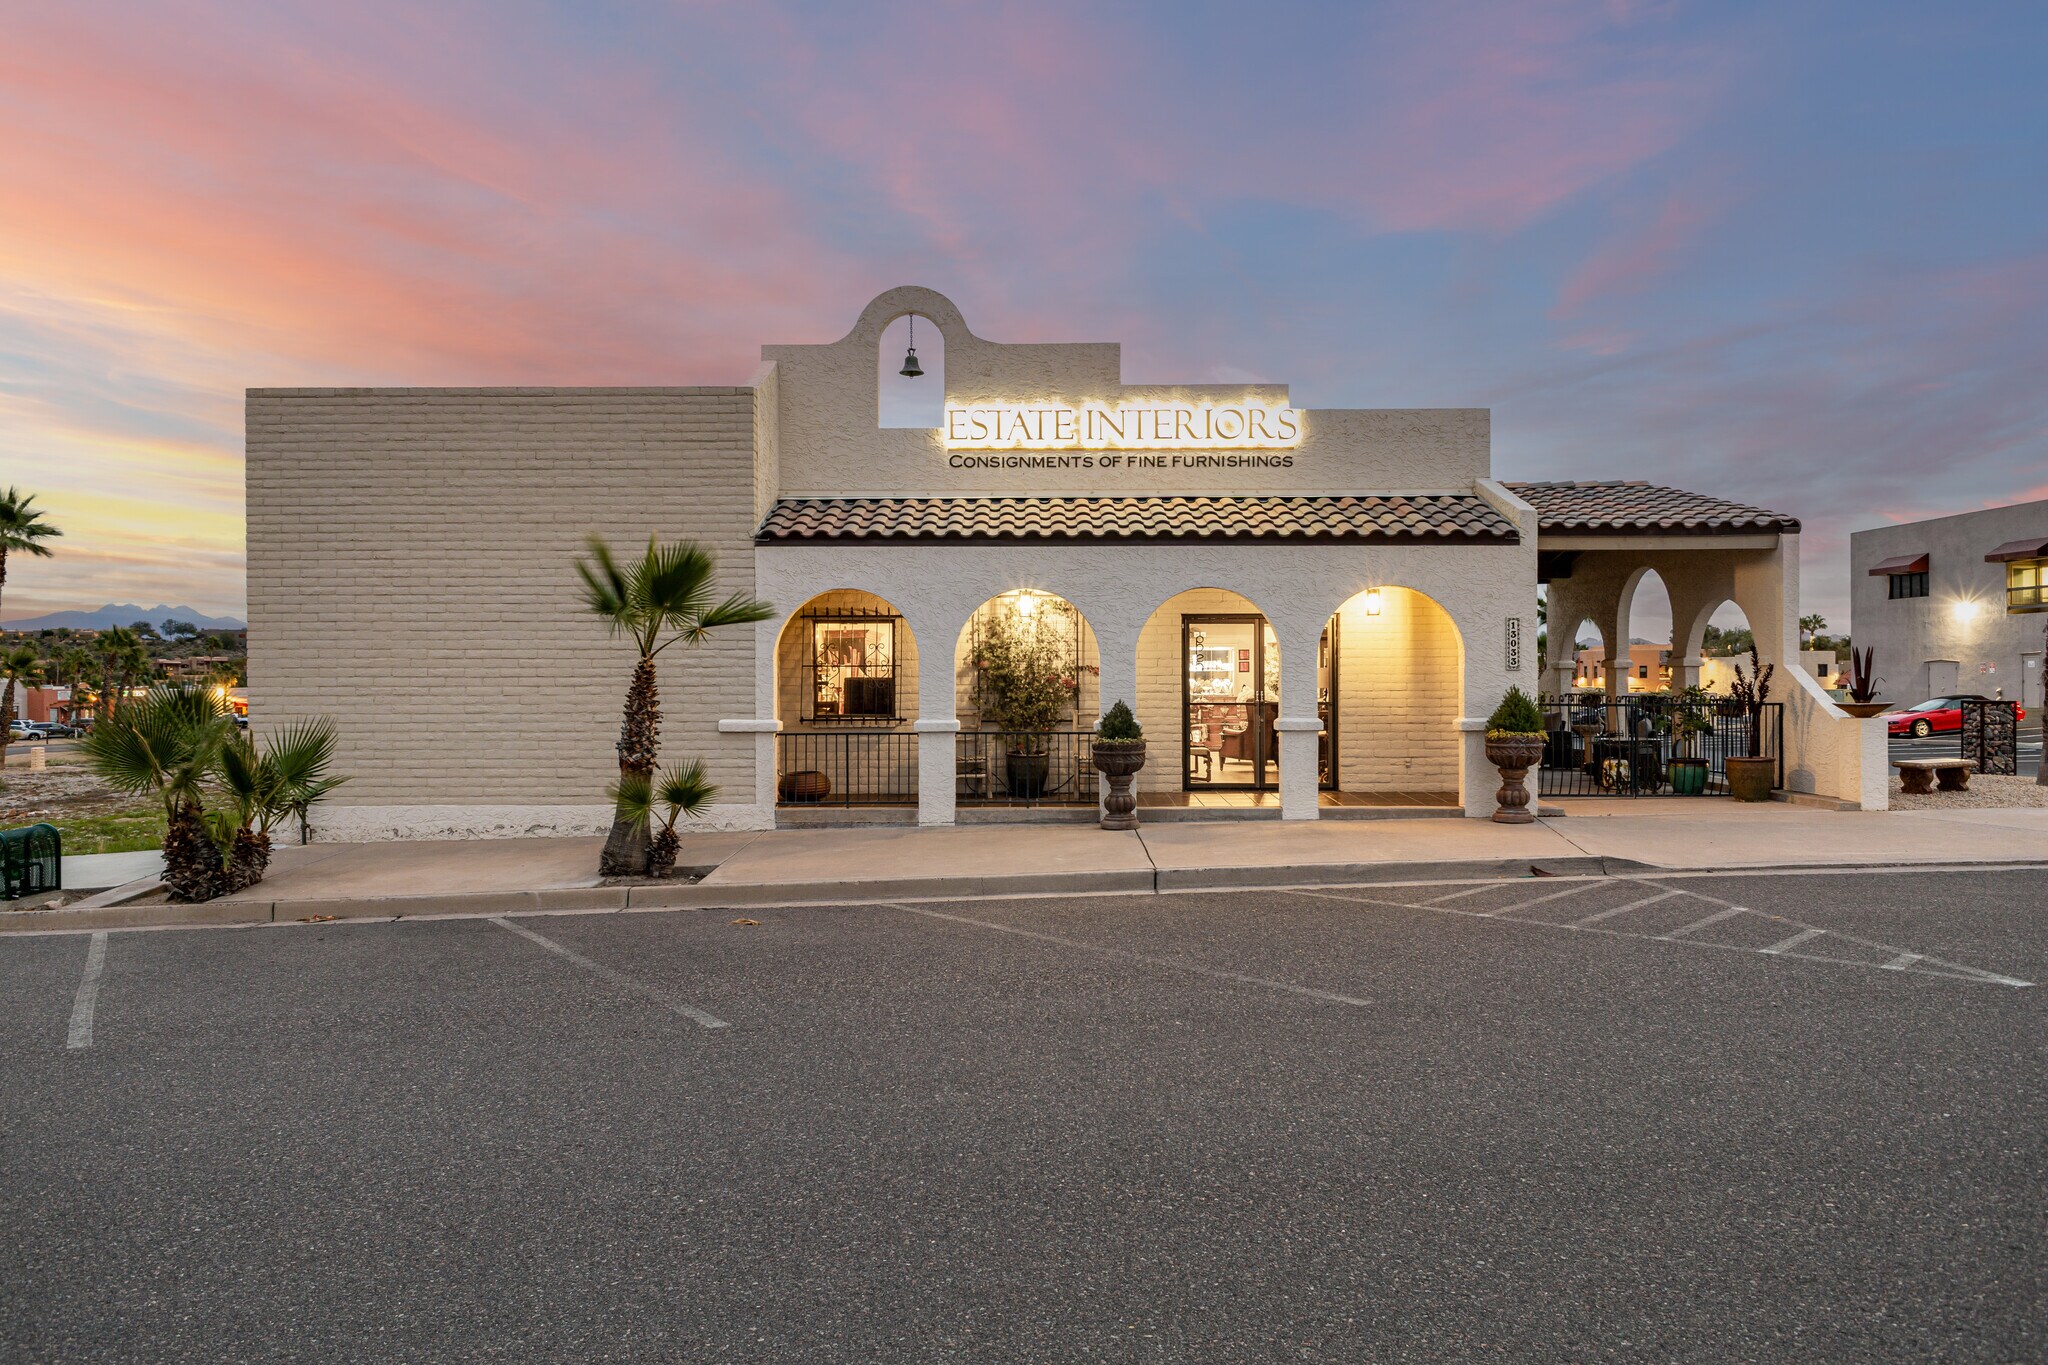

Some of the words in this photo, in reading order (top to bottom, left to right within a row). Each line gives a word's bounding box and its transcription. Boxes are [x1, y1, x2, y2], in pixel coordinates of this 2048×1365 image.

[948, 409, 1074, 441] ESTATE
[1086, 408, 1297, 440] INTERIORS
[949, 454, 1094, 468] CONSIGNMENTS
[1099, 455, 1123, 468] OF
[1127, 455, 1167, 468] FINE
[1172, 455, 1294, 467] FURNISHINGS
